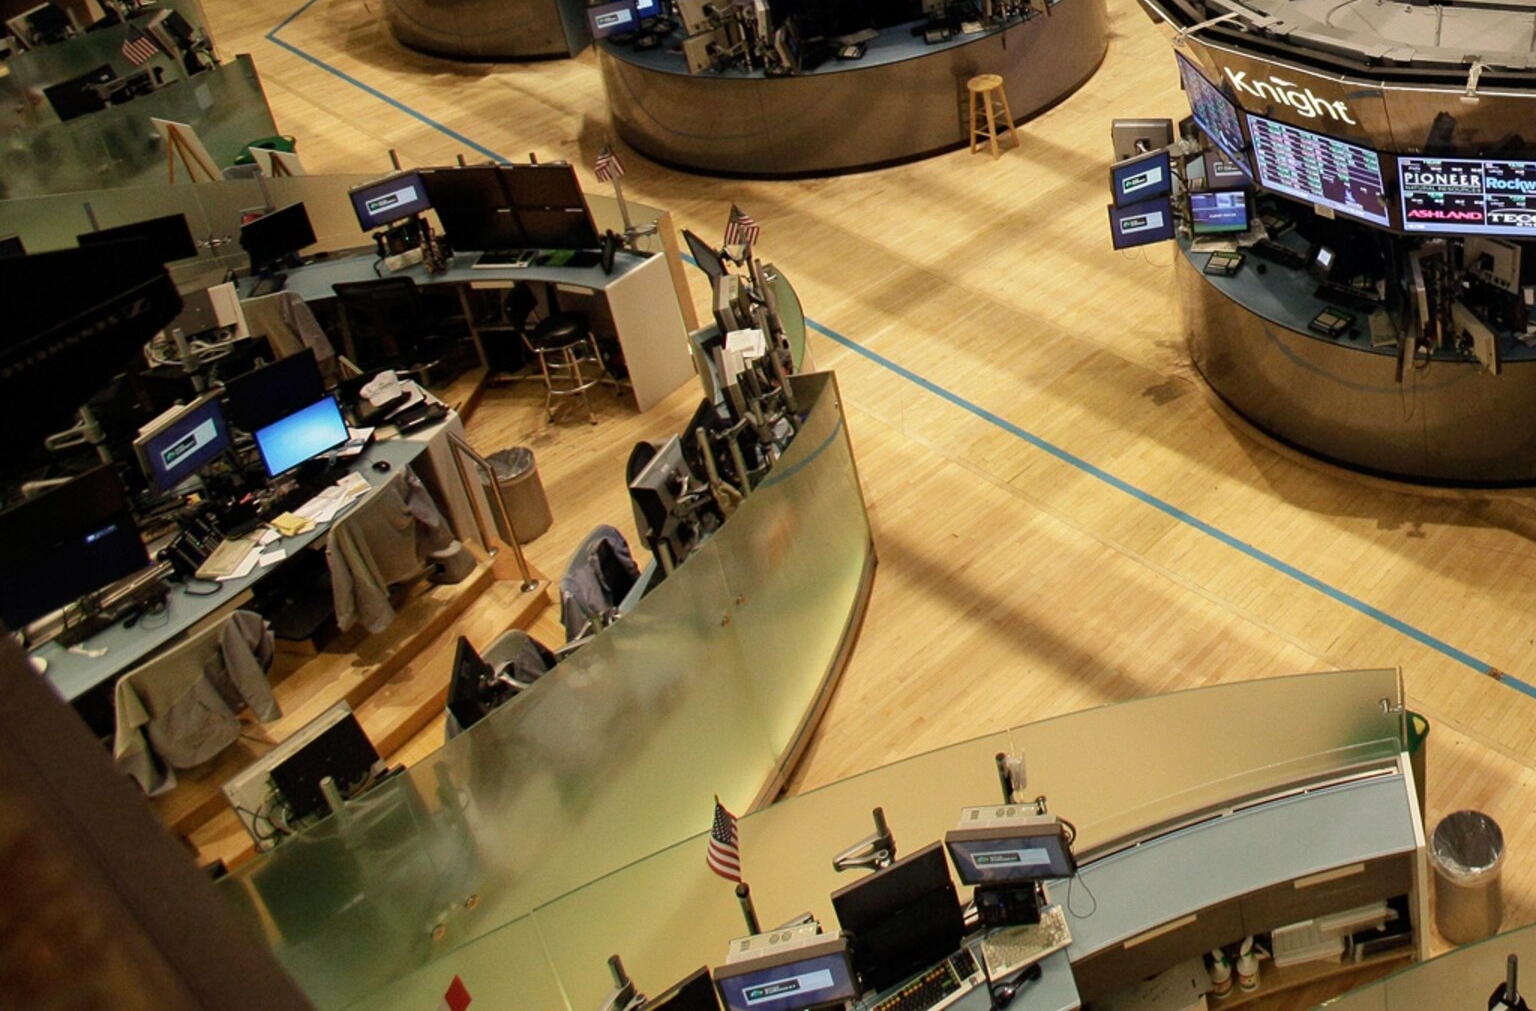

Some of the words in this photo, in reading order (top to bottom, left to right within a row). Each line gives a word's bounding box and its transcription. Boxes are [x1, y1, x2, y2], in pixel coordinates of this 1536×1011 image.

[1224, 66, 1357, 126] Knight
[1404, 172, 1481, 187] PIONEER
[1407, 209, 1483, 221] ASHLAND
